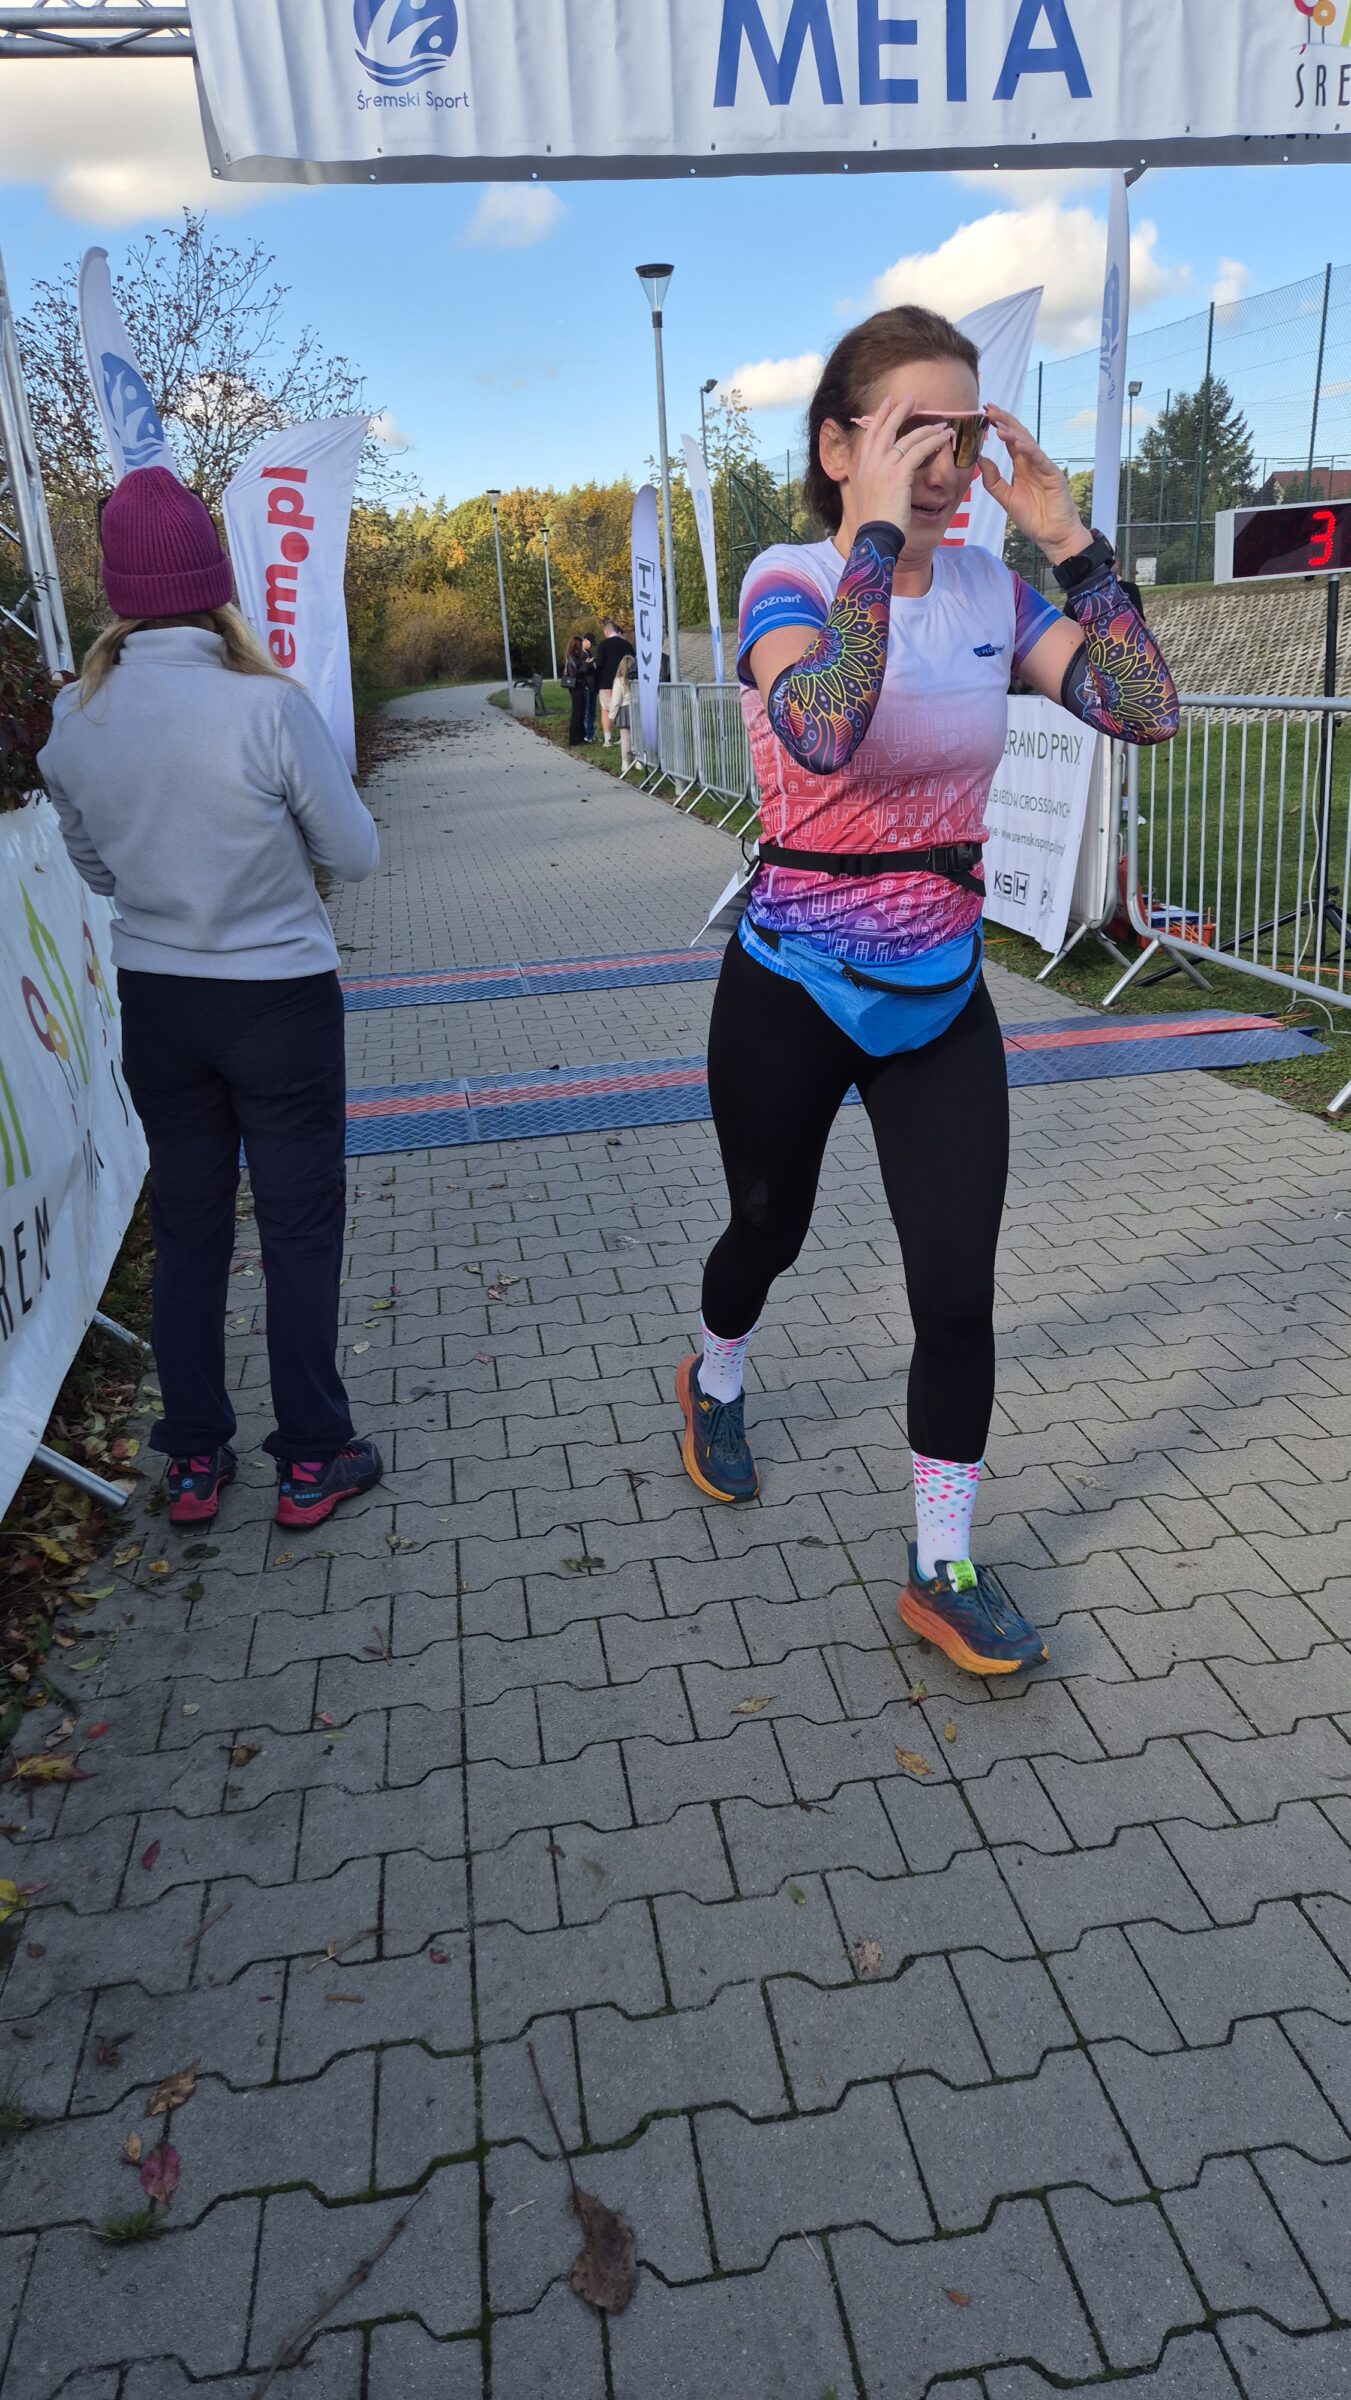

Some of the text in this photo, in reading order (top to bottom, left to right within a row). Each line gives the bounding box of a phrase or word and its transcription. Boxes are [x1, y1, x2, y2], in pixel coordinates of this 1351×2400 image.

[357, 89, 469, 111] Śremski Sport
[1308, 510, 1336, 566] 3
[1005, 730, 1083, 765] RAND PRIX
[994, 870, 1029, 903] KSH
